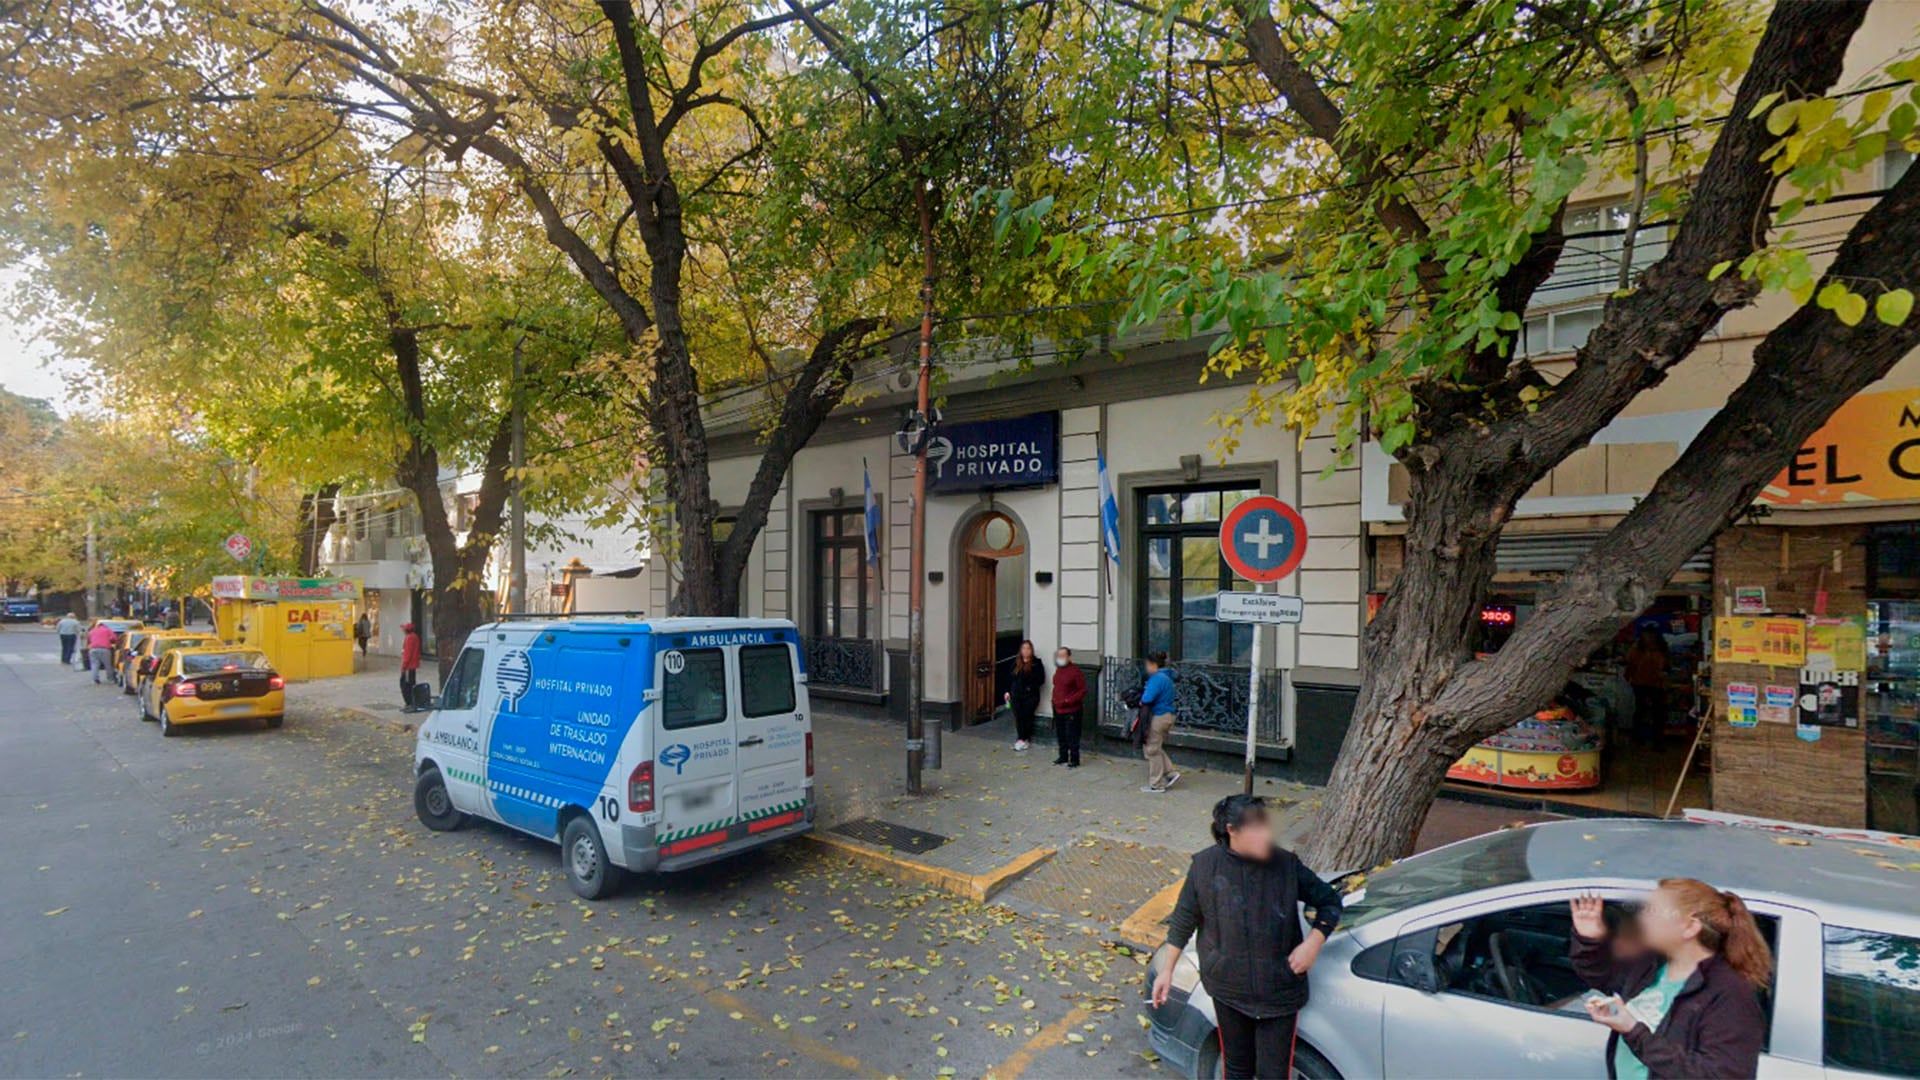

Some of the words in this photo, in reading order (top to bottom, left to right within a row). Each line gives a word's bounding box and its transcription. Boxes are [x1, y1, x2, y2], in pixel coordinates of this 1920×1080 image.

[957, 442, 1041, 459] HOSPITAL
[957, 459, 1042, 476] PRIVADO
[1788, 444, 1863, 486] EL
[691, 633, 765, 646] AMBULANCIA
[667, 654, 682, 669] 110
[535, 679, 572, 692] HOSPITAL
[576, 682, 613, 697] PRIVADO
[577, 711, 611, 726] UNIDAD
[794, 713, 804, 721] 10
[434, 731, 479, 751] AMBULANCIA
[550, 723, 563, 737] DE
[563, 725, 608, 746] TRASLADO
[693, 738, 732, 750] HOSPITAL
[693, 748, 729, 760] PRIVADO
[599, 795, 620, 822] 10
